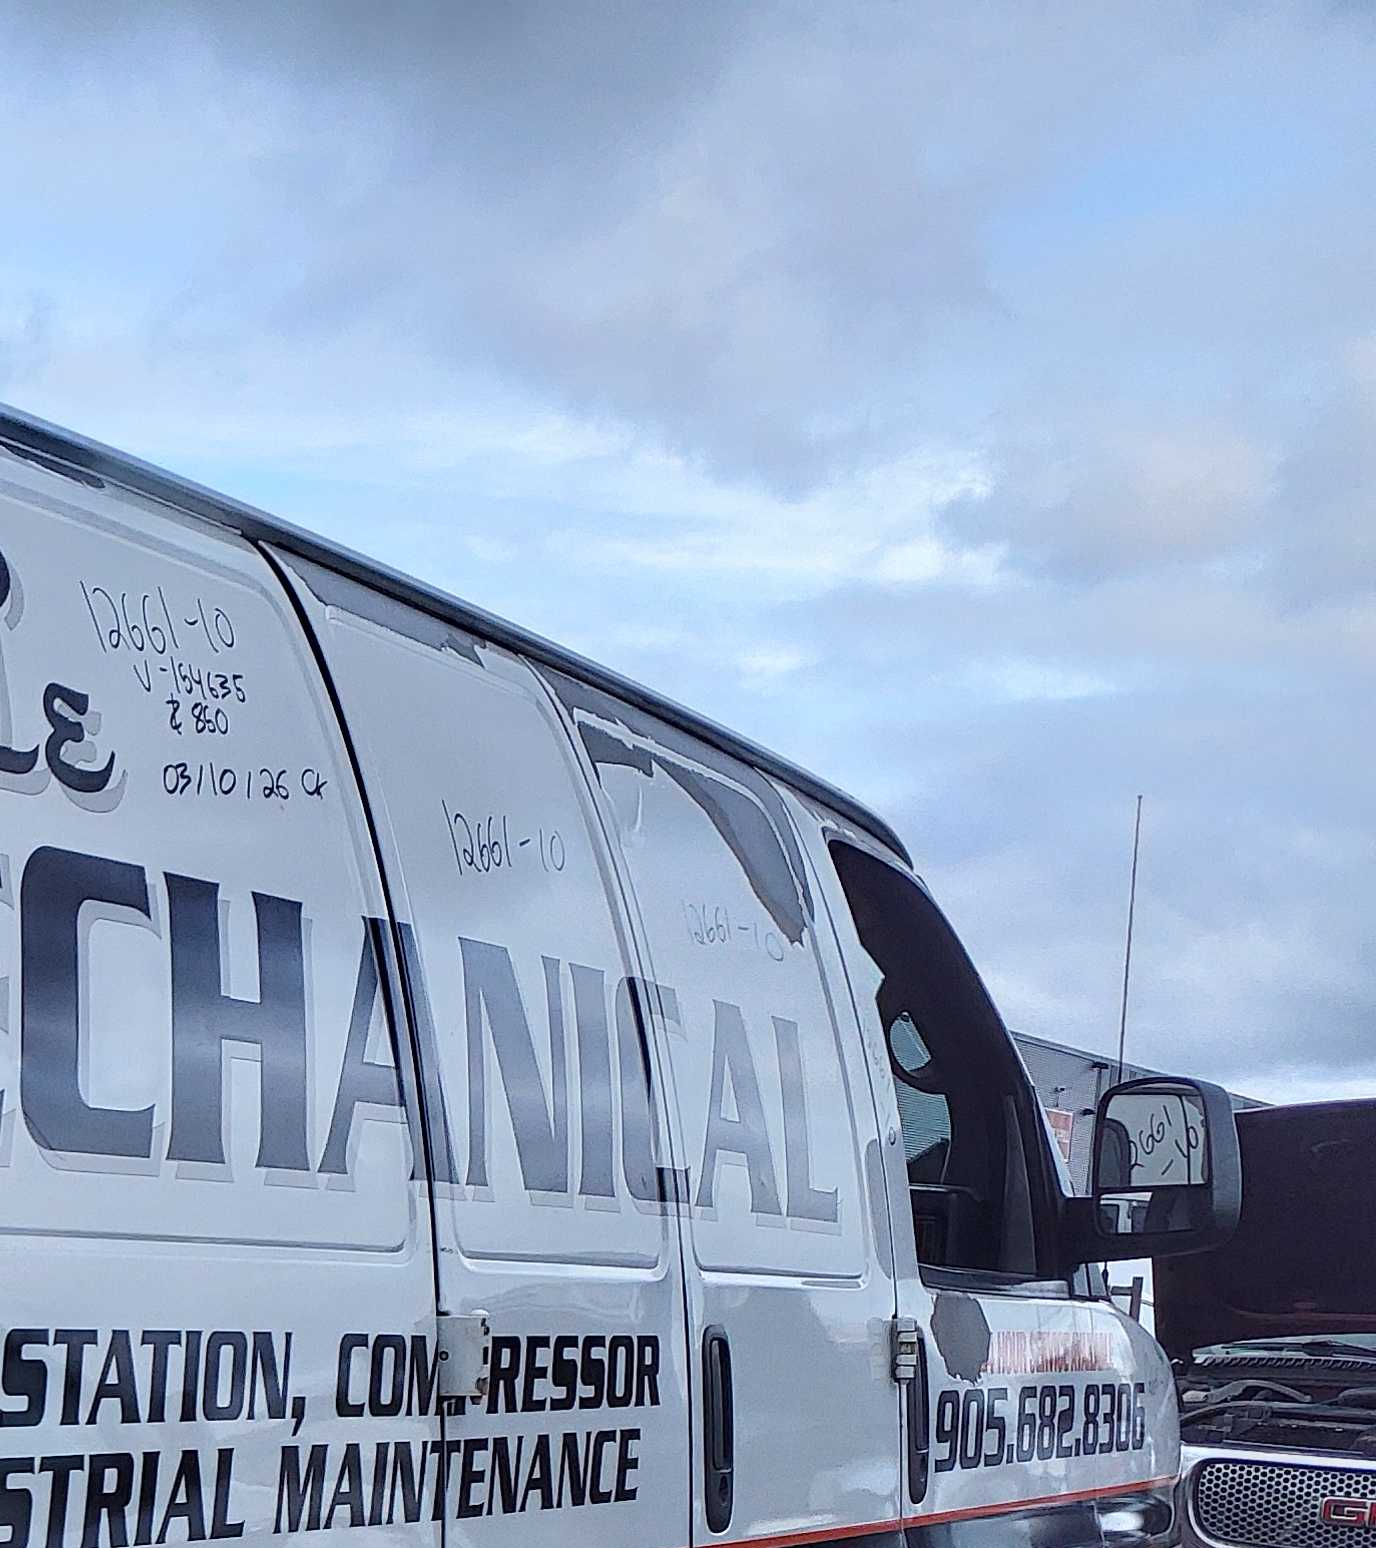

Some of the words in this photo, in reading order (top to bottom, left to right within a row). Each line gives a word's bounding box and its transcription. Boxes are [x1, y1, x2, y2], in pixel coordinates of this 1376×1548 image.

[80, 580, 235, 654] 12661-10
[192, 701, 229, 735] 850
[442, 799, 565, 875] 12661-10
[683, 900, 784, 961] 12661-10
[336, 1333, 660, 1417] COMRESSOR
[935, 1382, 1145, 1473] 905.682.8306
[274, 1428, 640, 1532] MAINTENANCE
